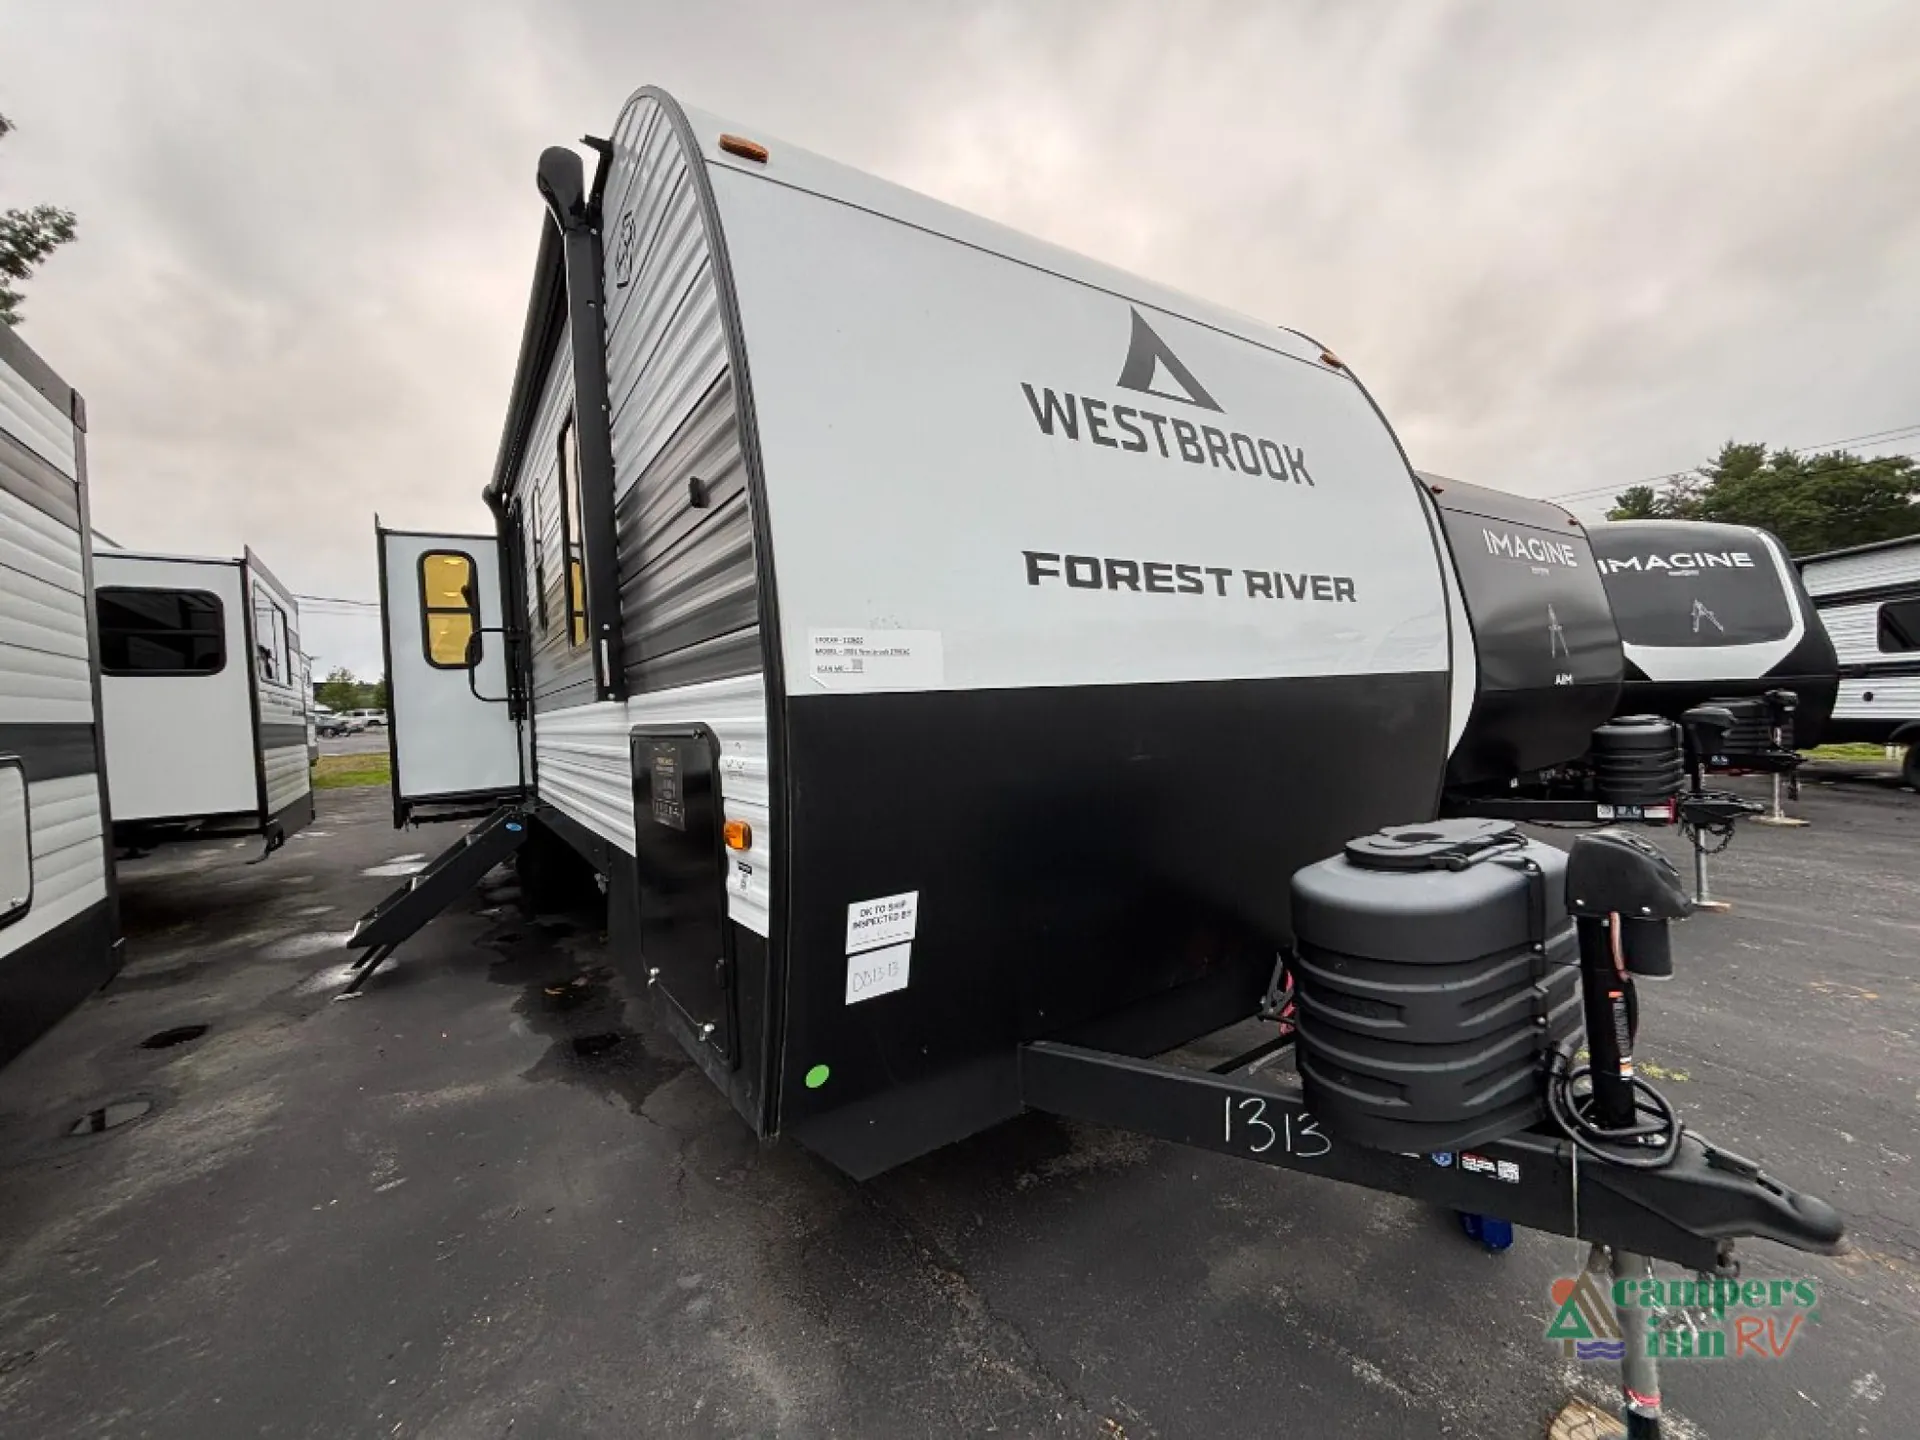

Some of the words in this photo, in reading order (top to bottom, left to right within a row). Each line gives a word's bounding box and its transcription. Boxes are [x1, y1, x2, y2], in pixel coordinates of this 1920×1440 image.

[1020, 382, 1315, 487] WESTBROOK
[1482, 528, 1578, 568] IMAGINE
[1597, 552, 1755, 575] IMAGINE
[1021, 550, 1233, 597] FOREST
[1242, 569, 1357, 602] RIVER
[875, 905, 886, 914] TO
[1225, 1096, 1332, 1157] 1313
